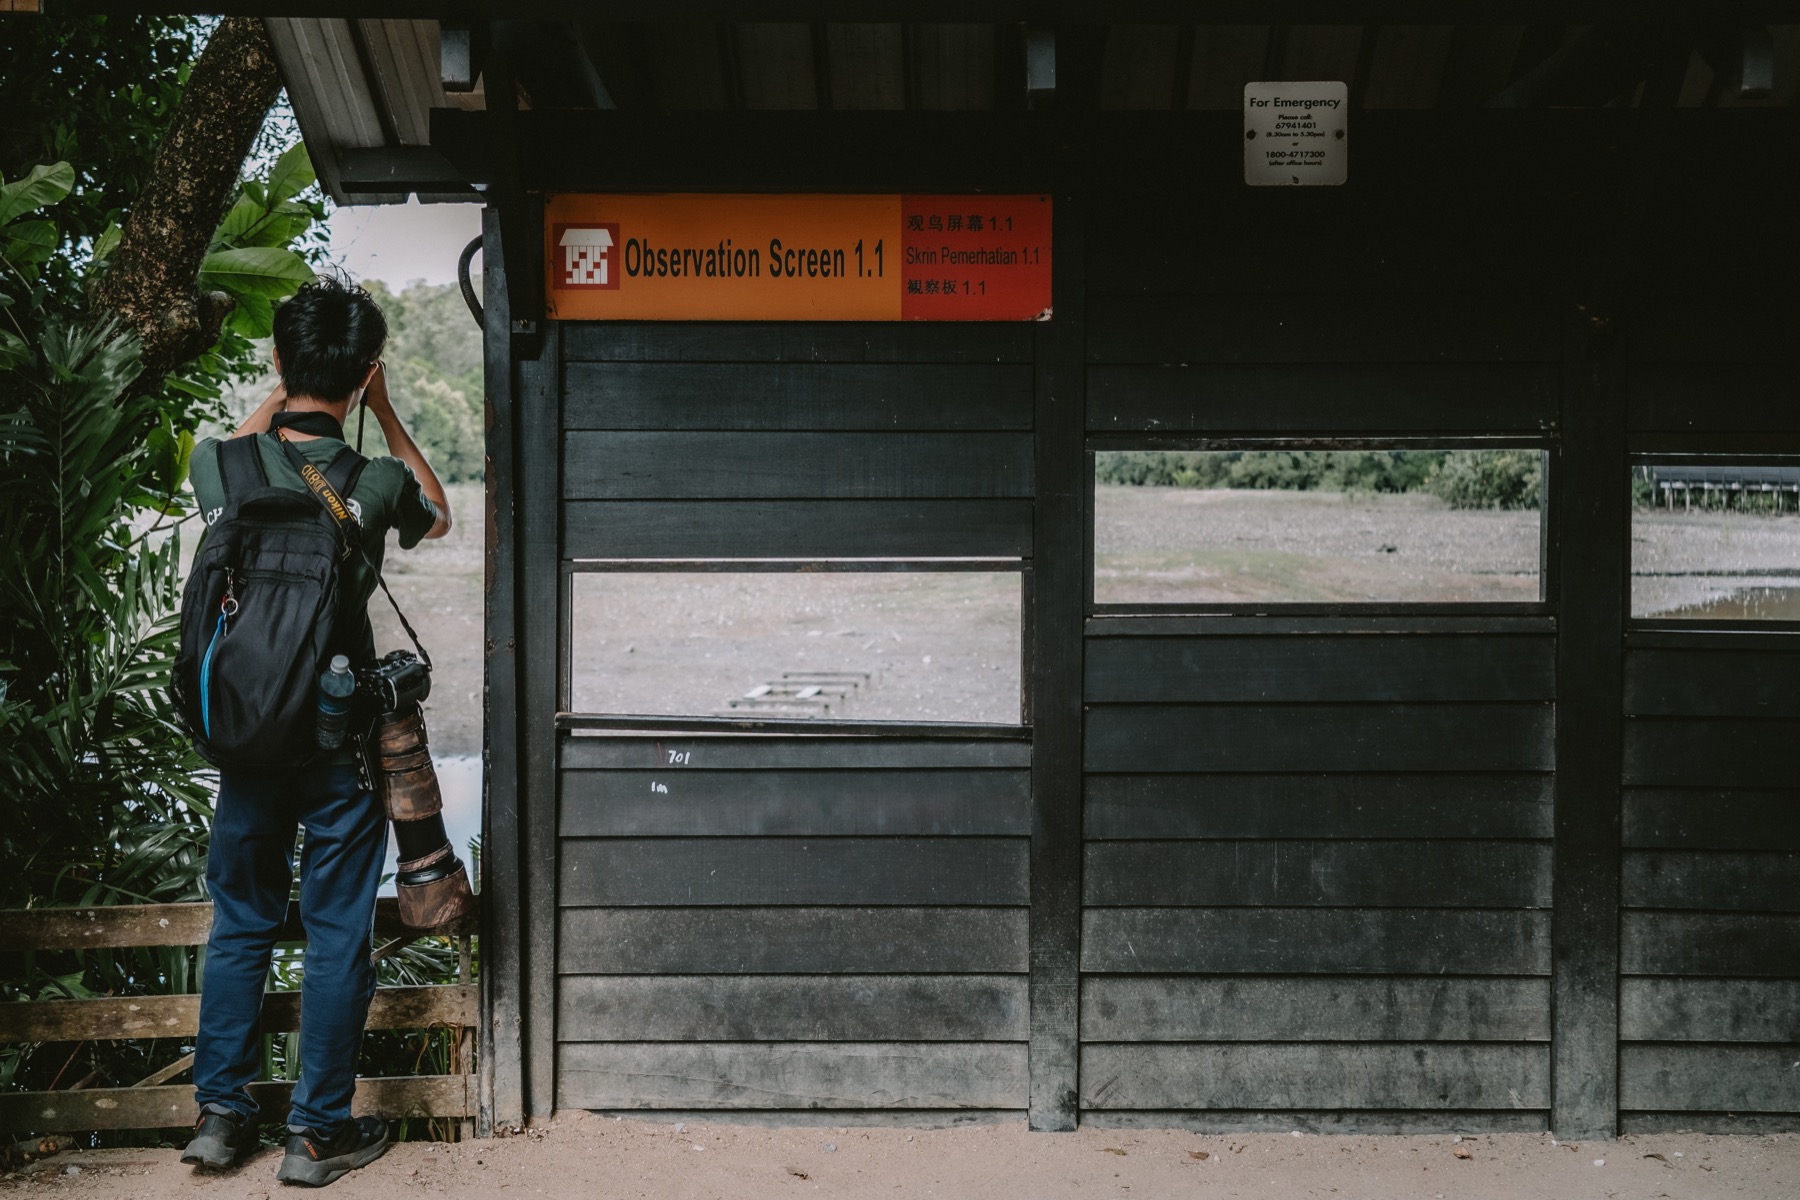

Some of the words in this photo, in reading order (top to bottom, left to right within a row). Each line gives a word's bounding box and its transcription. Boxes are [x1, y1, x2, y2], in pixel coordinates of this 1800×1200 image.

[1250, 97, 1270, 108] For
[1273, 97, 1341, 110] Emergency
[1275, 122, 1317, 130] 67941401
[907, 214, 984, 232] 观鸟屏幕
[989, 216, 1013, 231] 1.1
[624, 237, 761, 278] Observation
[769, 238, 845, 278] Screen
[854, 238, 884, 278] 1.1
[906, 246, 937, 265] Skrin
[941, 246, 1018, 265] Pemerhatian
[1022, 247, 1039, 265] 1.1
[962, 280, 986, 295] 1.1
[301, 464, 326, 493] D810
[322, 489, 348, 520] Nikon
[668, 749, 691, 765] 701
